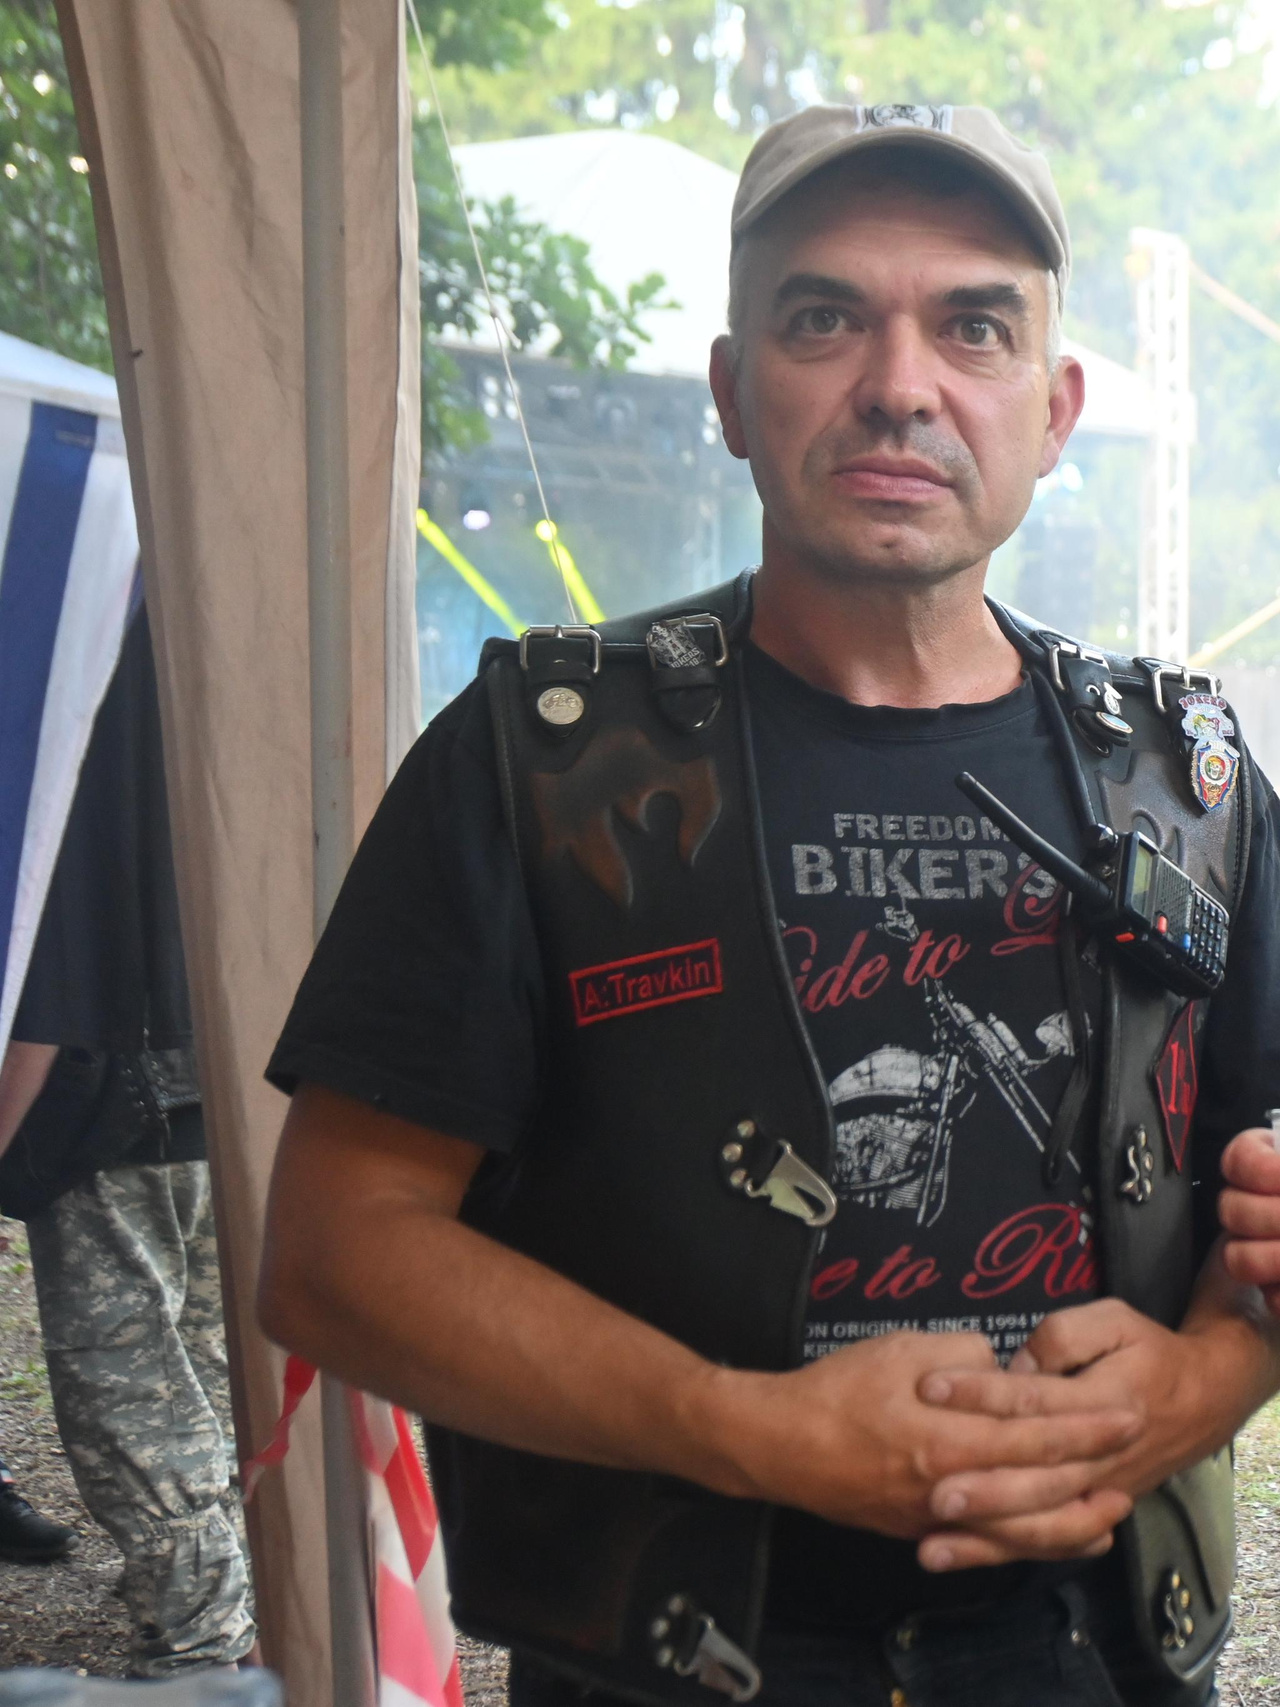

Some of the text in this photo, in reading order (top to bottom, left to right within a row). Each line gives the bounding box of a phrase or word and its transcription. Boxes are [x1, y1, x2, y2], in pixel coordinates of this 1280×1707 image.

[791, 844, 1056, 900] BIKERS
[903, 929, 971, 986] to
[864, 1244, 942, 1300] to
[926, 1315, 982, 1334] SINCE
[986, 1312, 1028, 1330] 1994
